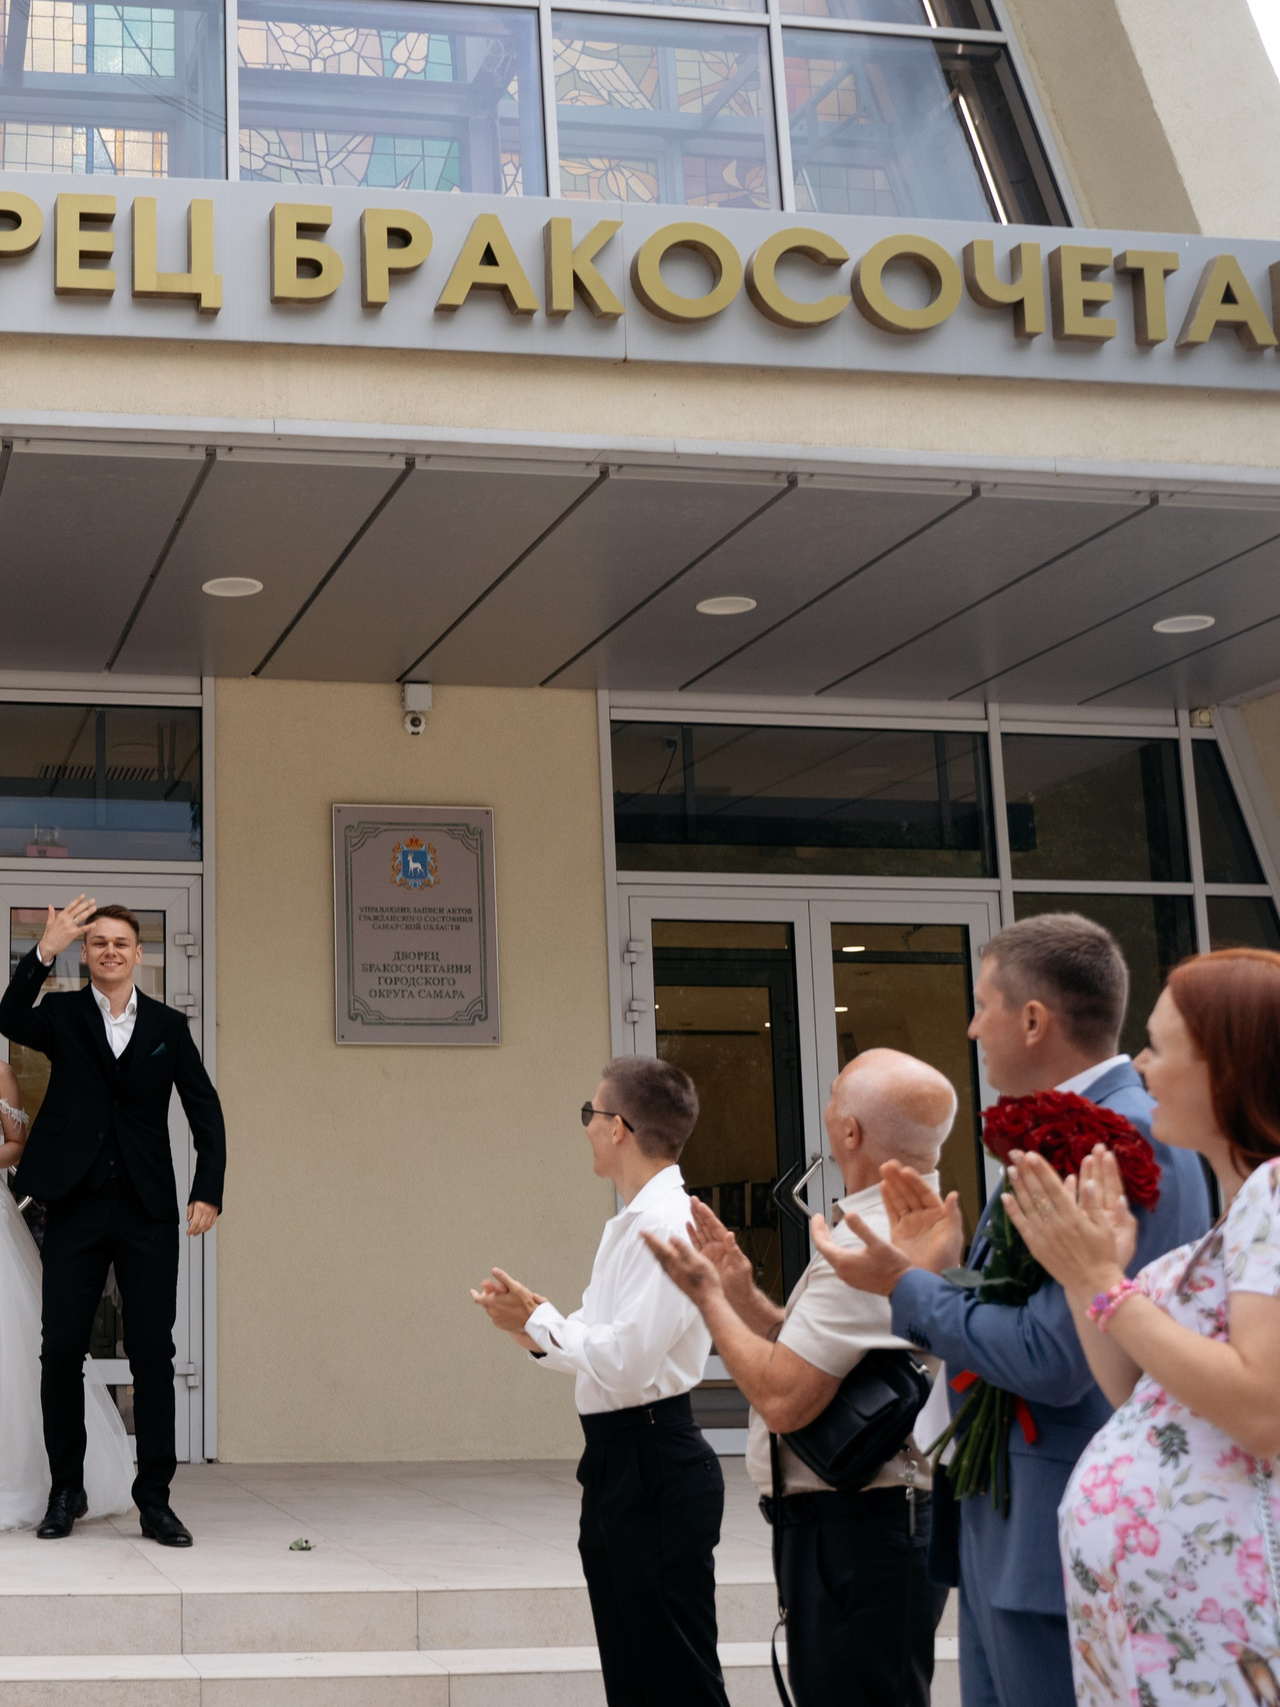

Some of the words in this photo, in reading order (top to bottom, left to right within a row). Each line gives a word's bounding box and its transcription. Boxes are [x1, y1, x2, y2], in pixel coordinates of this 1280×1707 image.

[269, 203, 1280, 352] БРАКОСОЧЕТА
[446, 907, 472, 915] АКТОВ
[358, 914, 422, 922] ГРАЖДАНСКОГО
[372, 923, 421, 931] САМАРСКОЙ
[423, 923, 460, 931] ОБЛАСТИ
[392, 951, 440, 962] ДВОРЕЦ
[361, 963, 472, 974] БРАКОСОЧЕТАНИЯ
[377, 976, 456, 987] ГОРОДСКОГО
[368, 988, 415, 998] ОКРУГА
[417, 989, 465, 999] САМАРА
